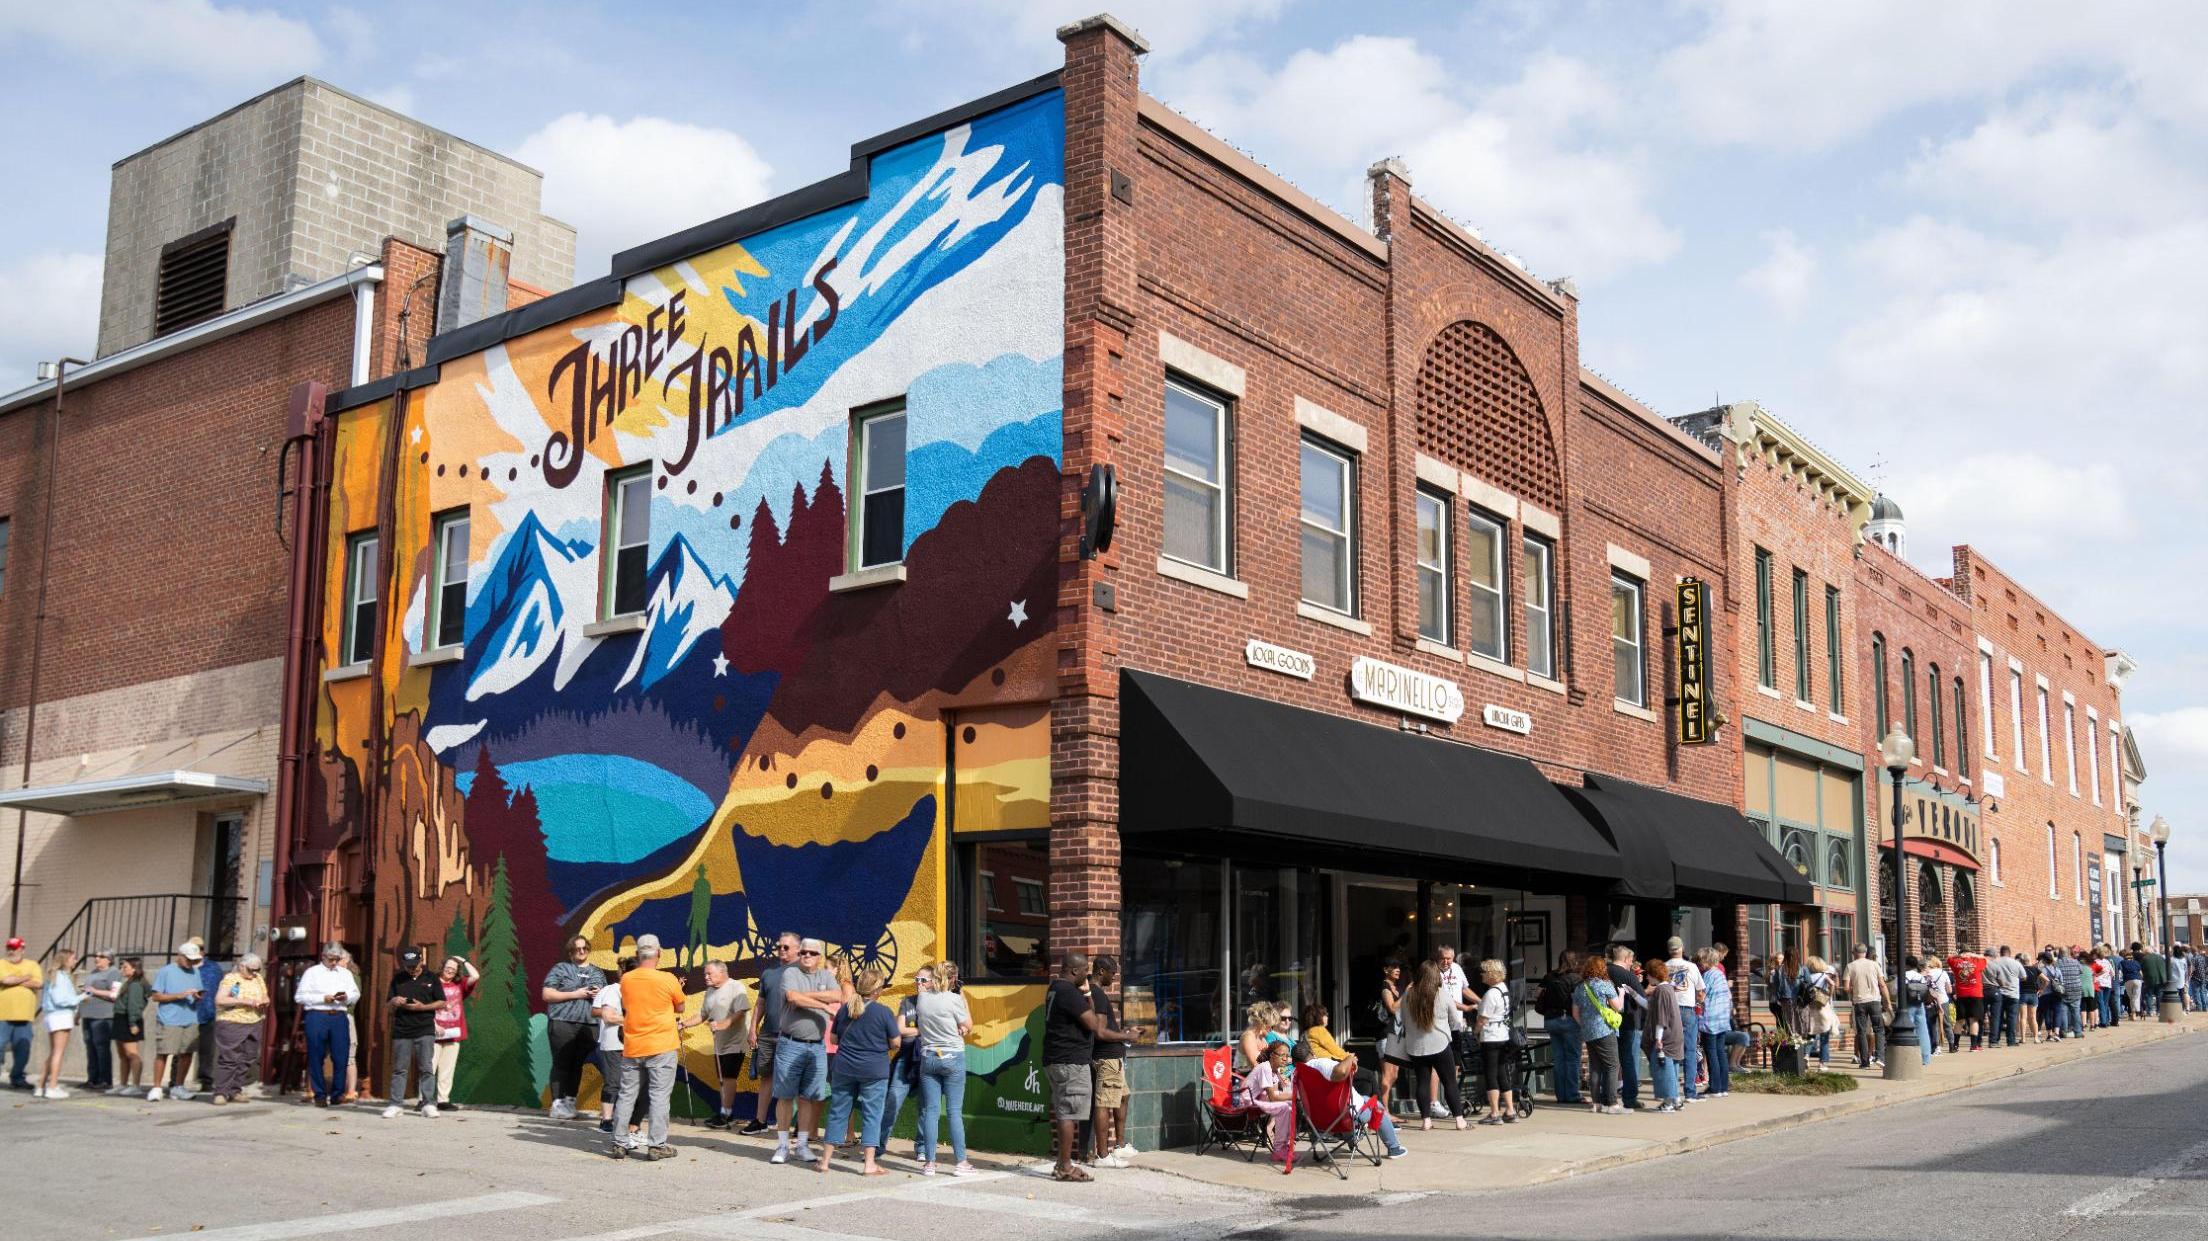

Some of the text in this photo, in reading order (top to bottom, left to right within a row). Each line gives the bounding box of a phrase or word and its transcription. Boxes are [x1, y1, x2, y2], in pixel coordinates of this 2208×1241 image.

[542, 288, 687, 489] THREE
[662, 257, 840, 477] TRAILS
[1253, 644, 1310, 674] LOCAL GOODS
[1365, 661, 1448, 712] MARINELLO
[1682, 588, 1700, 738] SENTINEL
